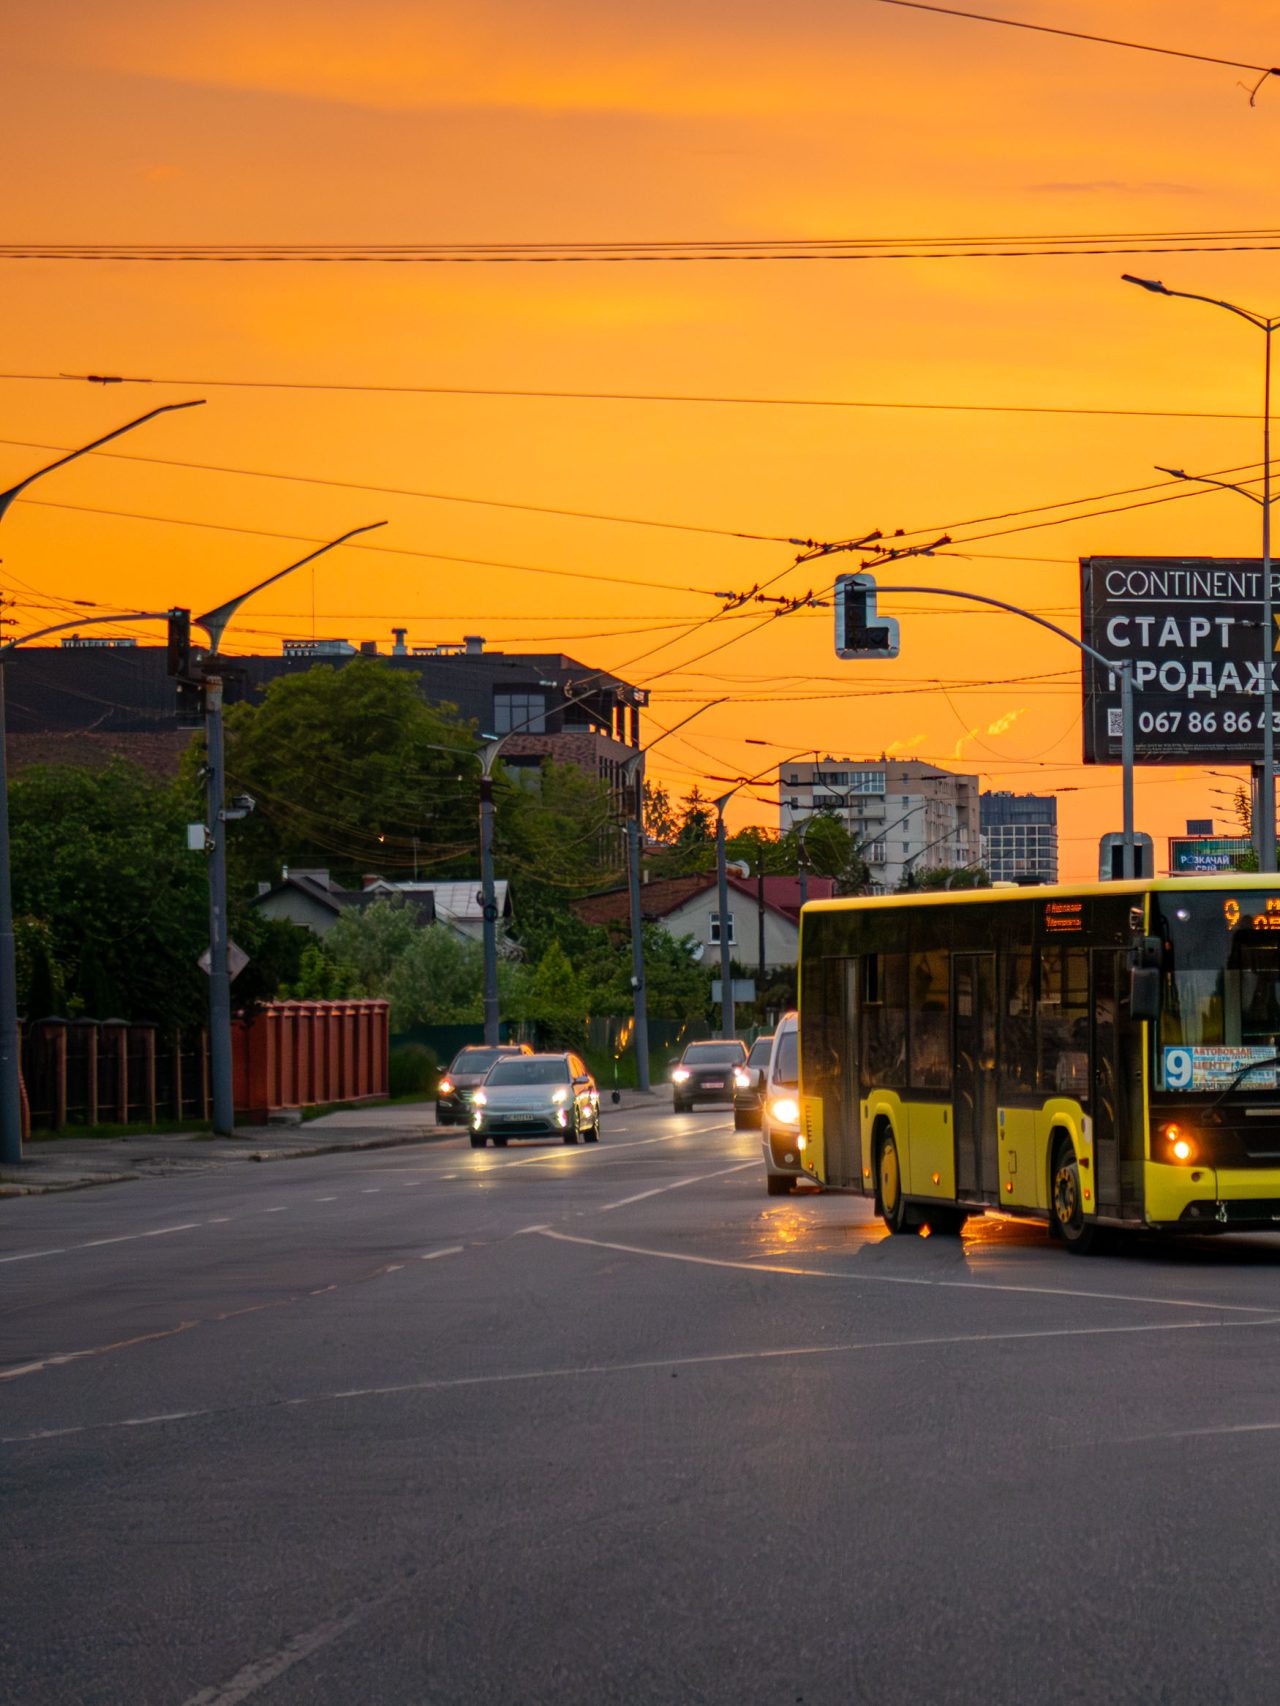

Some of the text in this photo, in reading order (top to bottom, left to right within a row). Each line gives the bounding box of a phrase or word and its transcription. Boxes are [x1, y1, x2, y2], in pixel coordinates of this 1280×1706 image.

[1105, 570, 1262, 597] CONTINENT
[1106, 616, 1235, 648] СТАРТ
[1139, 711, 1182, 733] 067
[1188, 711, 1217, 733] 86
[1223, 711, 1252, 733] 86
[1224, 899, 1241, 931] 9
[1166, 1050, 1192, 1087] 9
